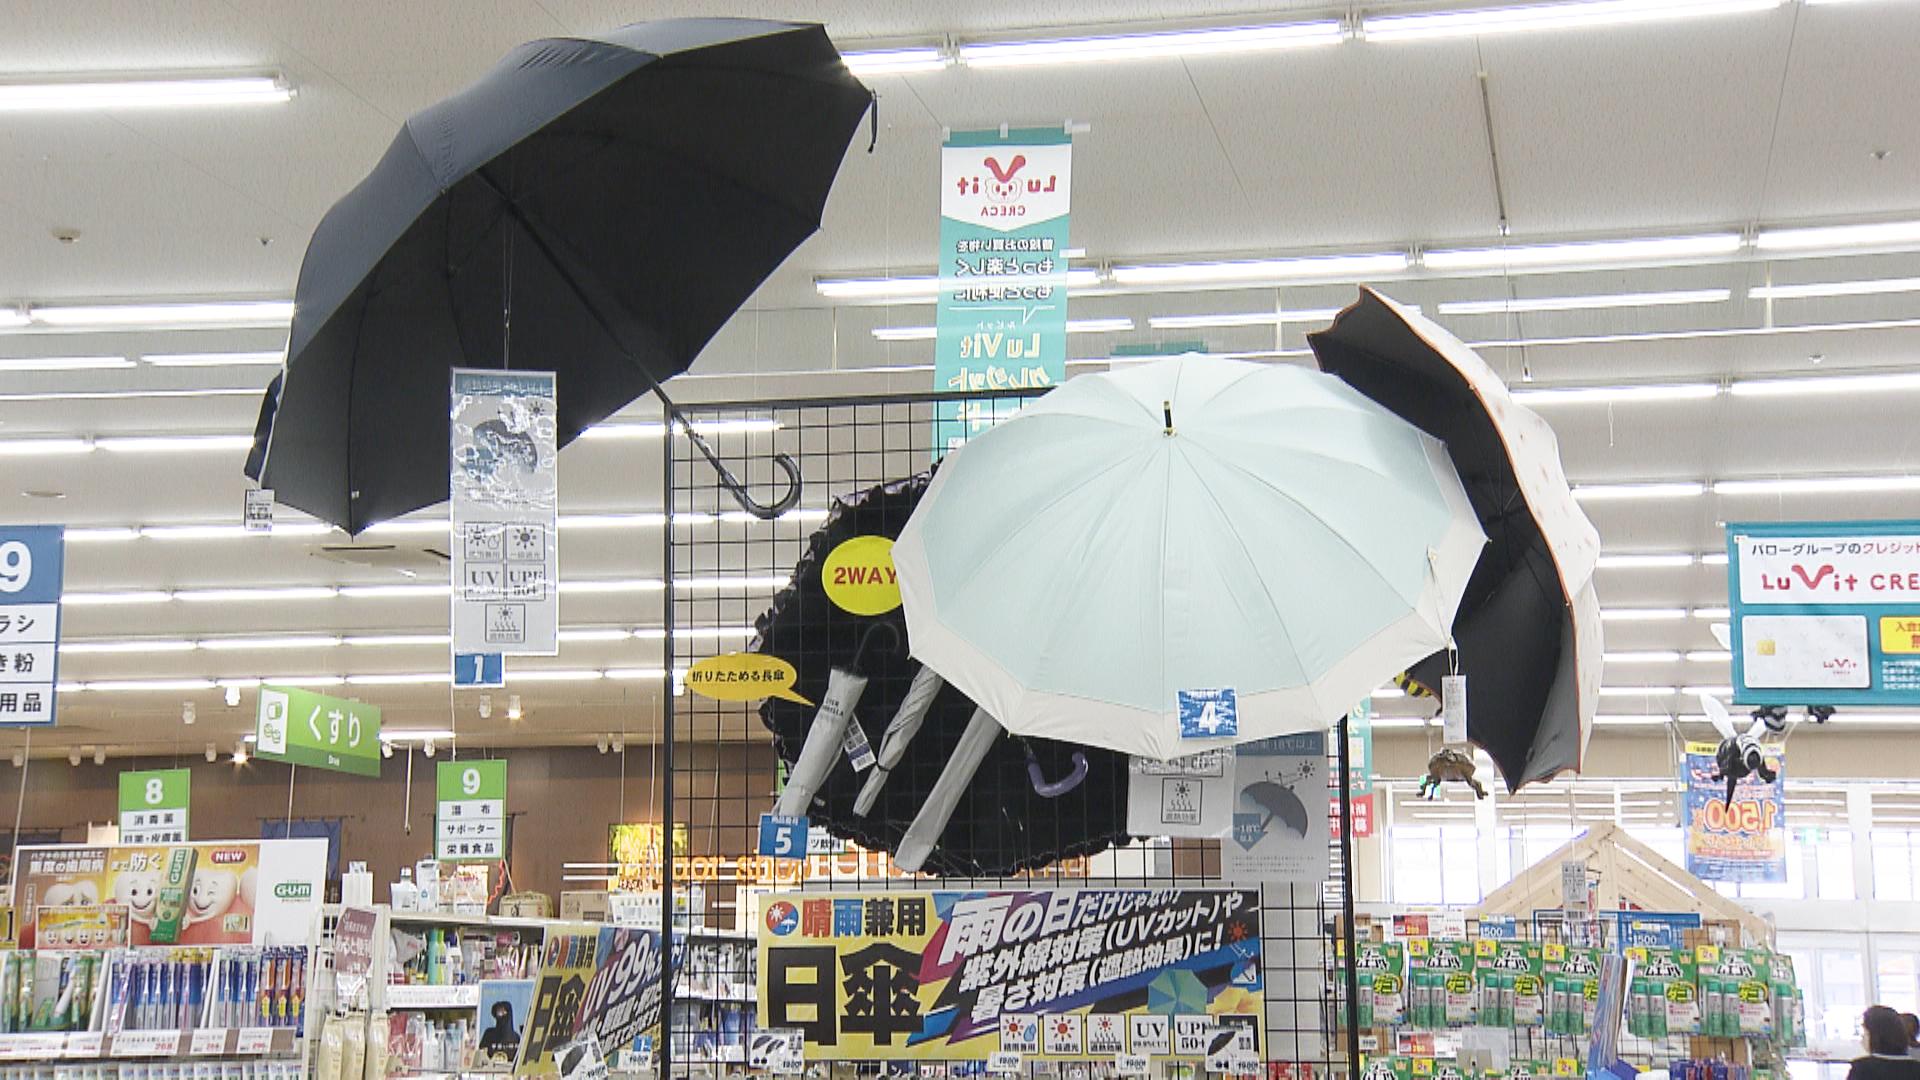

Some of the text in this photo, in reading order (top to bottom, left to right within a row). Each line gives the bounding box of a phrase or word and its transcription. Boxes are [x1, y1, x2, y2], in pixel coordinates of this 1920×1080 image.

[471, 571, 499, 585] UV
[833, 566, 899, 585] 2WAY
[1762, 564, 1858, 591] LuVit
[473, 655, 485, 683] 1
[692, 669, 785, 682] 折りたためる長傘
[308, 704, 361, 749] くすり
[1198, 701, 1218, 734] 4
[145, 778, 164, 805] 8
[462, 767, 481, 796] 9
[447, 823, 496, 835] サポーター
[774, 827, 792, 854] 5
[215, 851, 242, 862] NEW
[446, 842, 494, 855] 栄養食品
[802, 898, 926, 938] 晴雨兼用
[767, 943, 924, 1046] 日傘
[1136, 1023, 1165, 1038] UV
